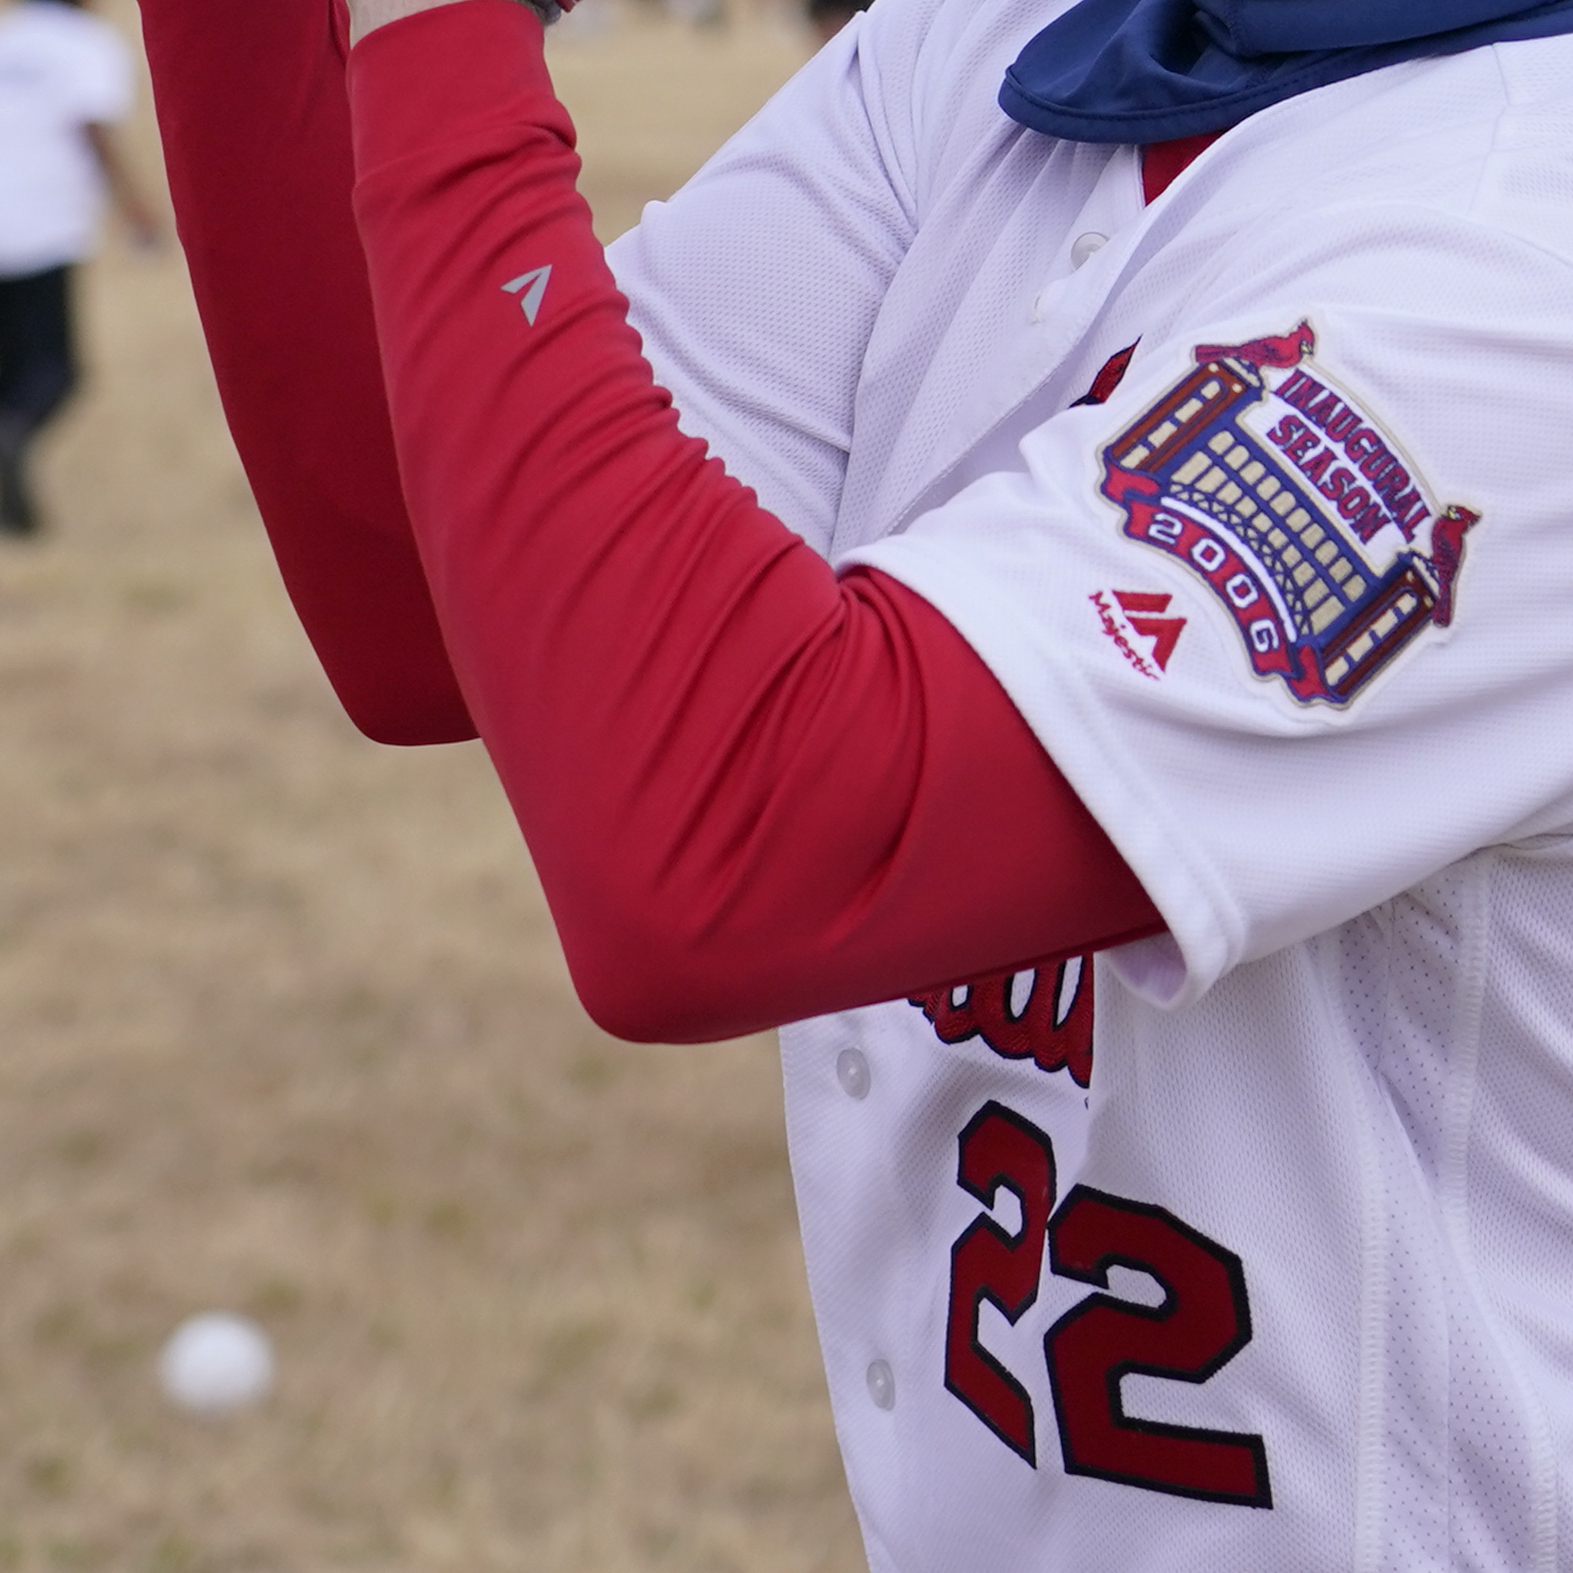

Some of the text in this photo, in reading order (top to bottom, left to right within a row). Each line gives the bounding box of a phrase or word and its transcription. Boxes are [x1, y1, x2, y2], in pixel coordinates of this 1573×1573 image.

[1266, 414, 1392, 545] SEASON
[1271, 368, 1432, 544] INAUGURAL
[1088, 591, 1161, 680] Majestic
[1147, 512, 1279, 653] 2006
[944, 1100, 1274, 1510] 22
